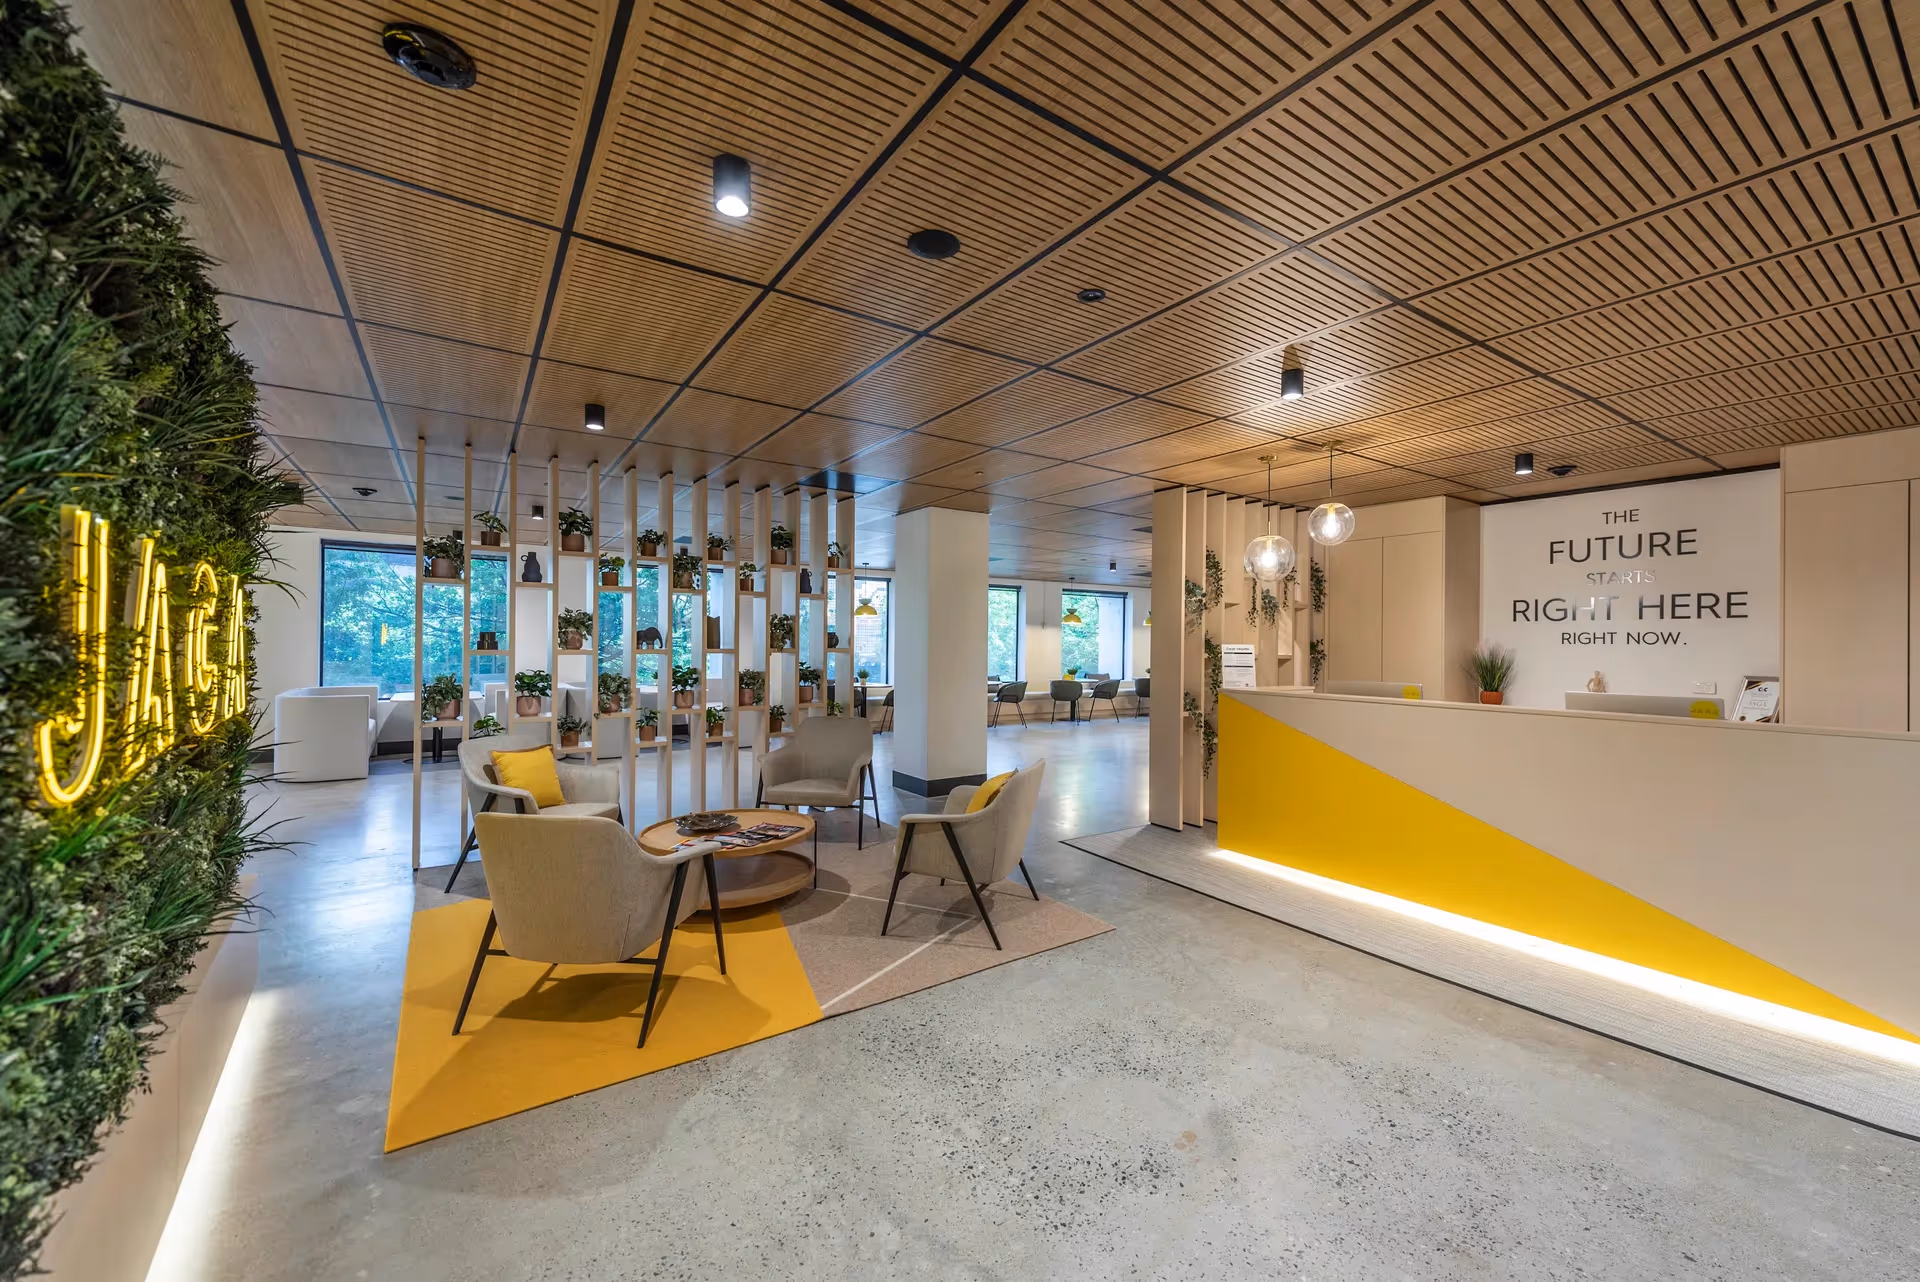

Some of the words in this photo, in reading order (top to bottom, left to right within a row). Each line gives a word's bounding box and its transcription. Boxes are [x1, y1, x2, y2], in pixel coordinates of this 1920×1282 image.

[1602, 508, 1640, 525] THE
[1549, 528, 1698, 565] FUTURE
[1586, 569, 1656, 586] STARTS
[1512, 595, 1619, 623] RIGHT
[1638, 591, 1749, 620] HERE
[1561, 632, 1617, 646] RIGHT
[1626, 631, 1687, 646] NOW.
[36, 505, 247, 804] JAGA
